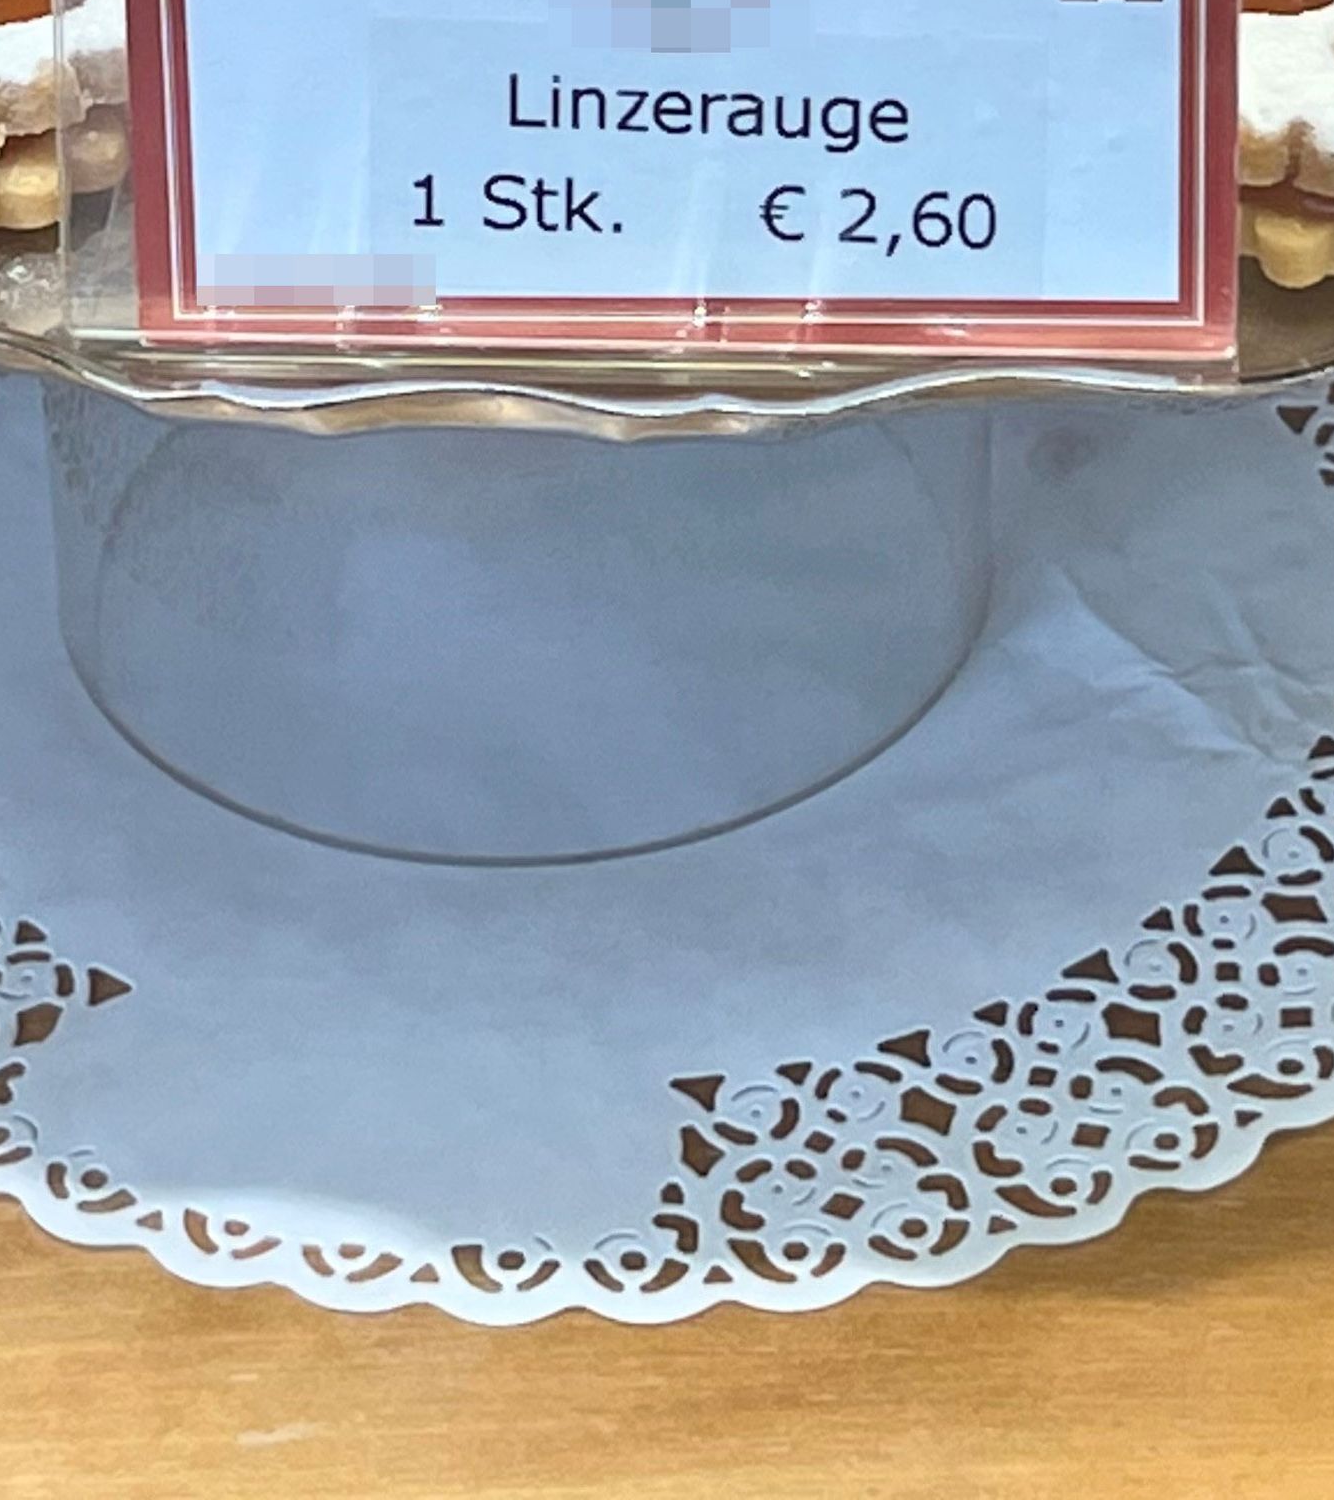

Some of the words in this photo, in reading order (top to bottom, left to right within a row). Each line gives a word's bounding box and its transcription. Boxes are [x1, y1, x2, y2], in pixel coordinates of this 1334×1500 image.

[508, 72, 910, 153] Linzerauge
[412, 174, 444, 228] 1
[483, 174, 623, 234] Stk.
[758, 184, 807, 242] €
[837, 188, 998, 257] 2,60
